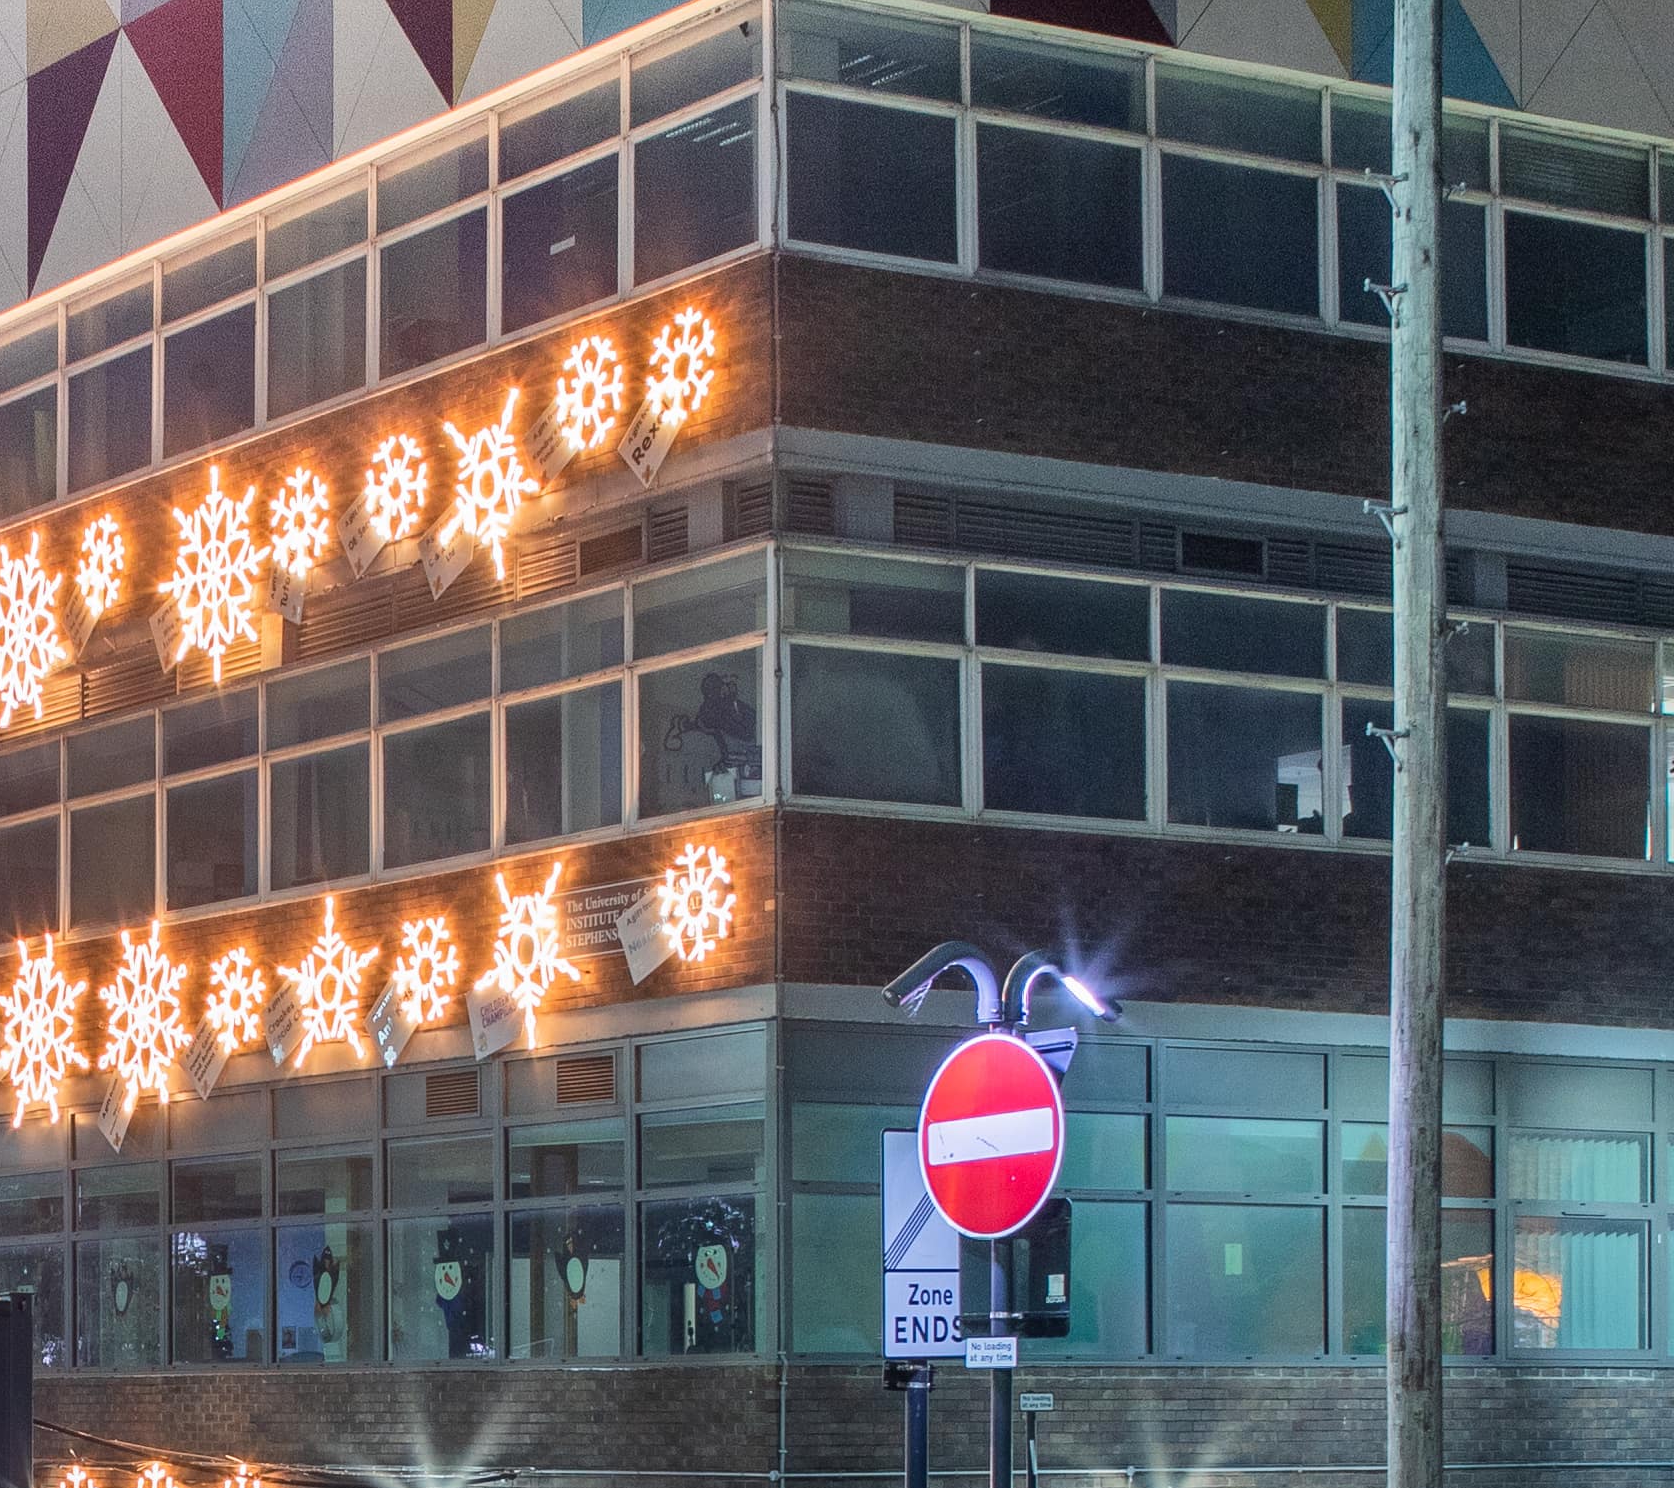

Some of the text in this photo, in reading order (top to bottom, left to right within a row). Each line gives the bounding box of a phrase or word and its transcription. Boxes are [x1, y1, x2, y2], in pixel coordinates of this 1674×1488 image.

[567, 888, 641, 913] The University of
[566, 909, 619, 931] INSTITUTE
[566, 928, 618, 949] STEPHENS
[907, 1283, 953, 1306] Zone
[894, 1316, 964, 1343] ENDS
[971, 1342, 1012, 1352] No loading
[980, 1354, 993, 1362] any
[996, 1353, 1013, 1361] time
